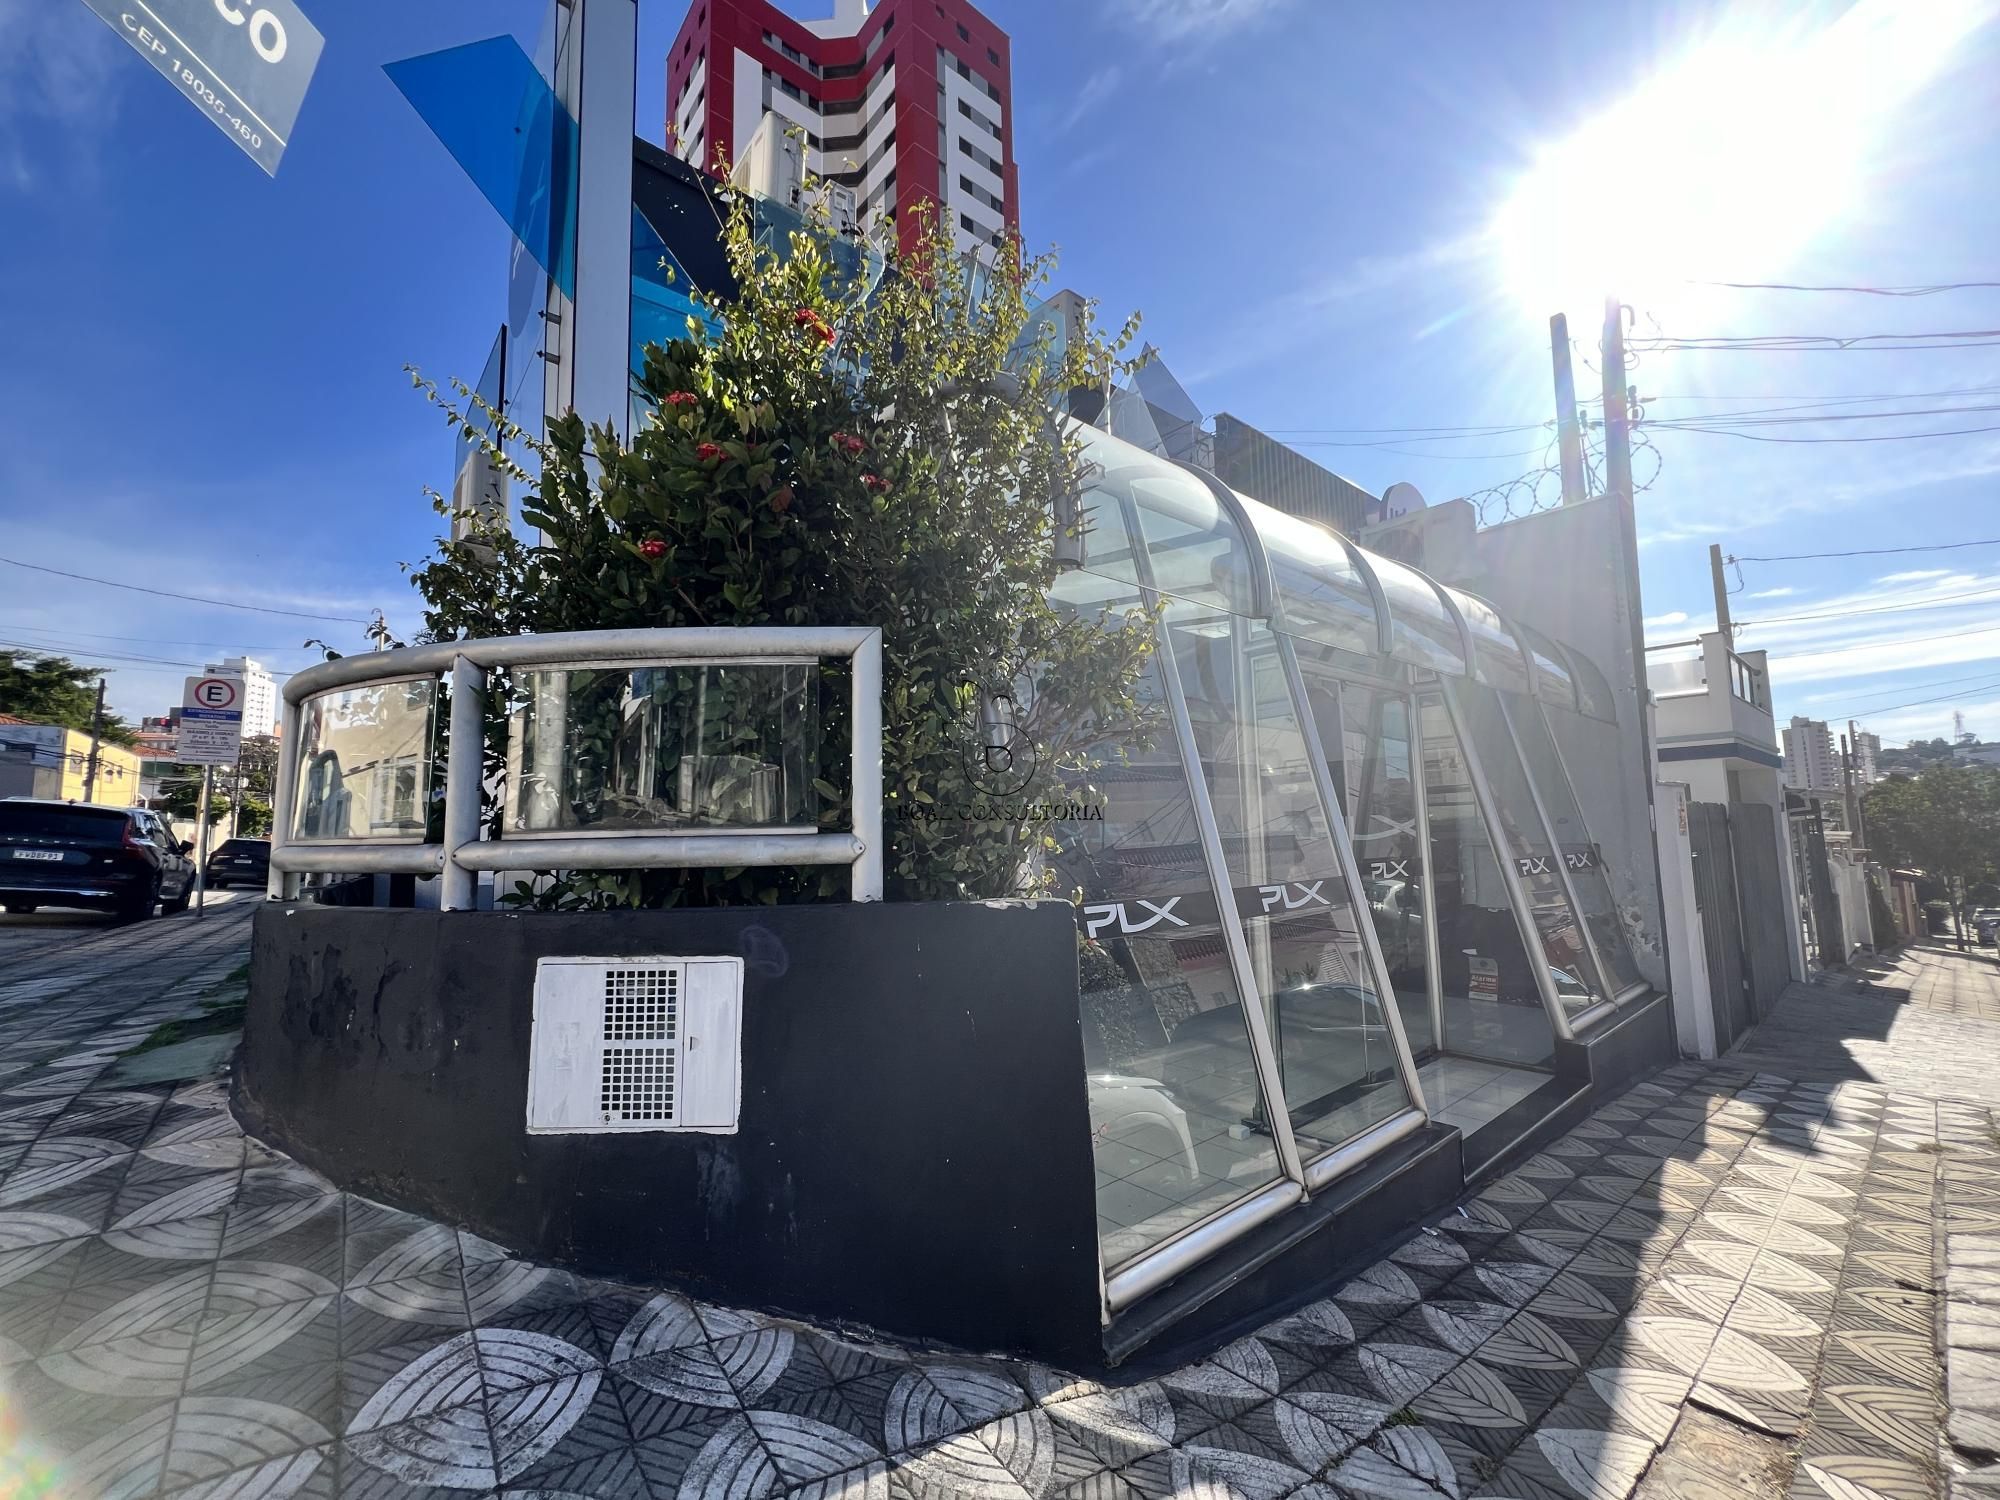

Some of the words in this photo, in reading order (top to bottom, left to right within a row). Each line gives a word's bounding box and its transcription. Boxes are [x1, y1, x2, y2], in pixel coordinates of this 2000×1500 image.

[121, 13, 168, 55] CEP
[172, 59, 262, 149] 18035-460
[206, 686, 223, 702] E
[1370, 860, 1409, 881] PLX
[1519, 857, 1550, 876] PLX
[1566, 852, 1593, 869] PLX
[1258, 880, 1331, 913] PLX
[1083, 896, 1190, 939] PLX
